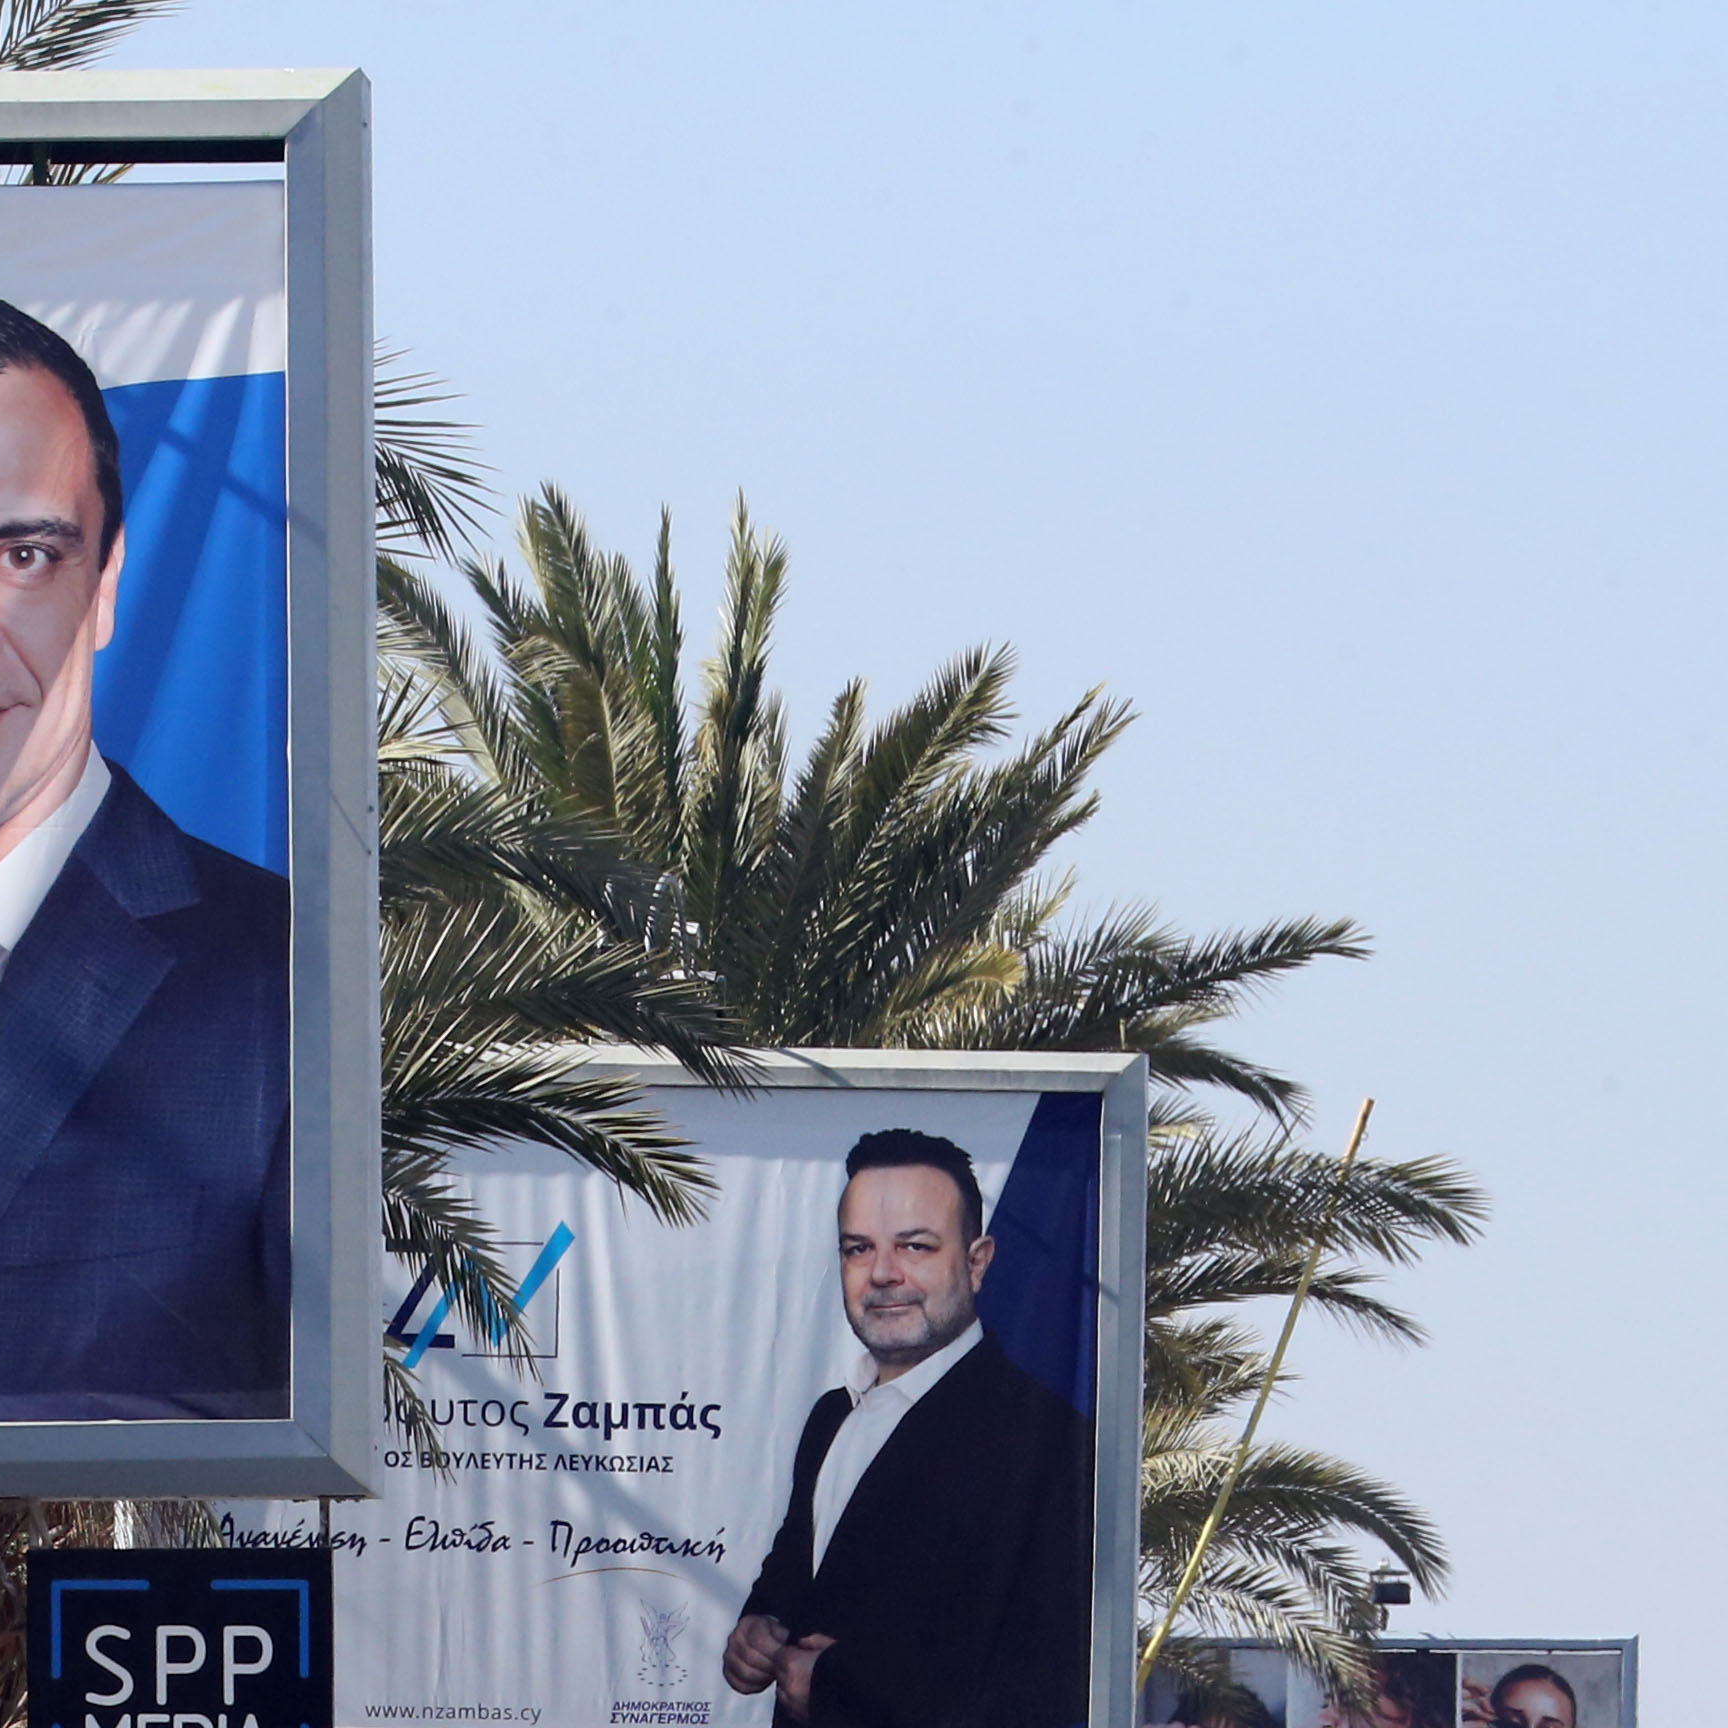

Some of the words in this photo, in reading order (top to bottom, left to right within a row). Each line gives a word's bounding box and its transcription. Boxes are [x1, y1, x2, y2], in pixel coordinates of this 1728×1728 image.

[542, 1391, 722, 1440] Ζαμπάς
[420, 1450, 548, 1471] ΒΟΥΛΕΥΤΗΣ
[553, 1453, 675, 1474] ΛΕΥΚΩΣΙΑΣ
[84, 1624, 274, 1707] SPP
[364, 1702, 542, 1725] www.nzambas.cy
[611, 1700, 712, 1713] ΔΗΜΟΚΡΑΤΙΚΟΣ
[608, 1712, 710, 1725] ΣΥΝΑΓΕΡΜΟΣ
